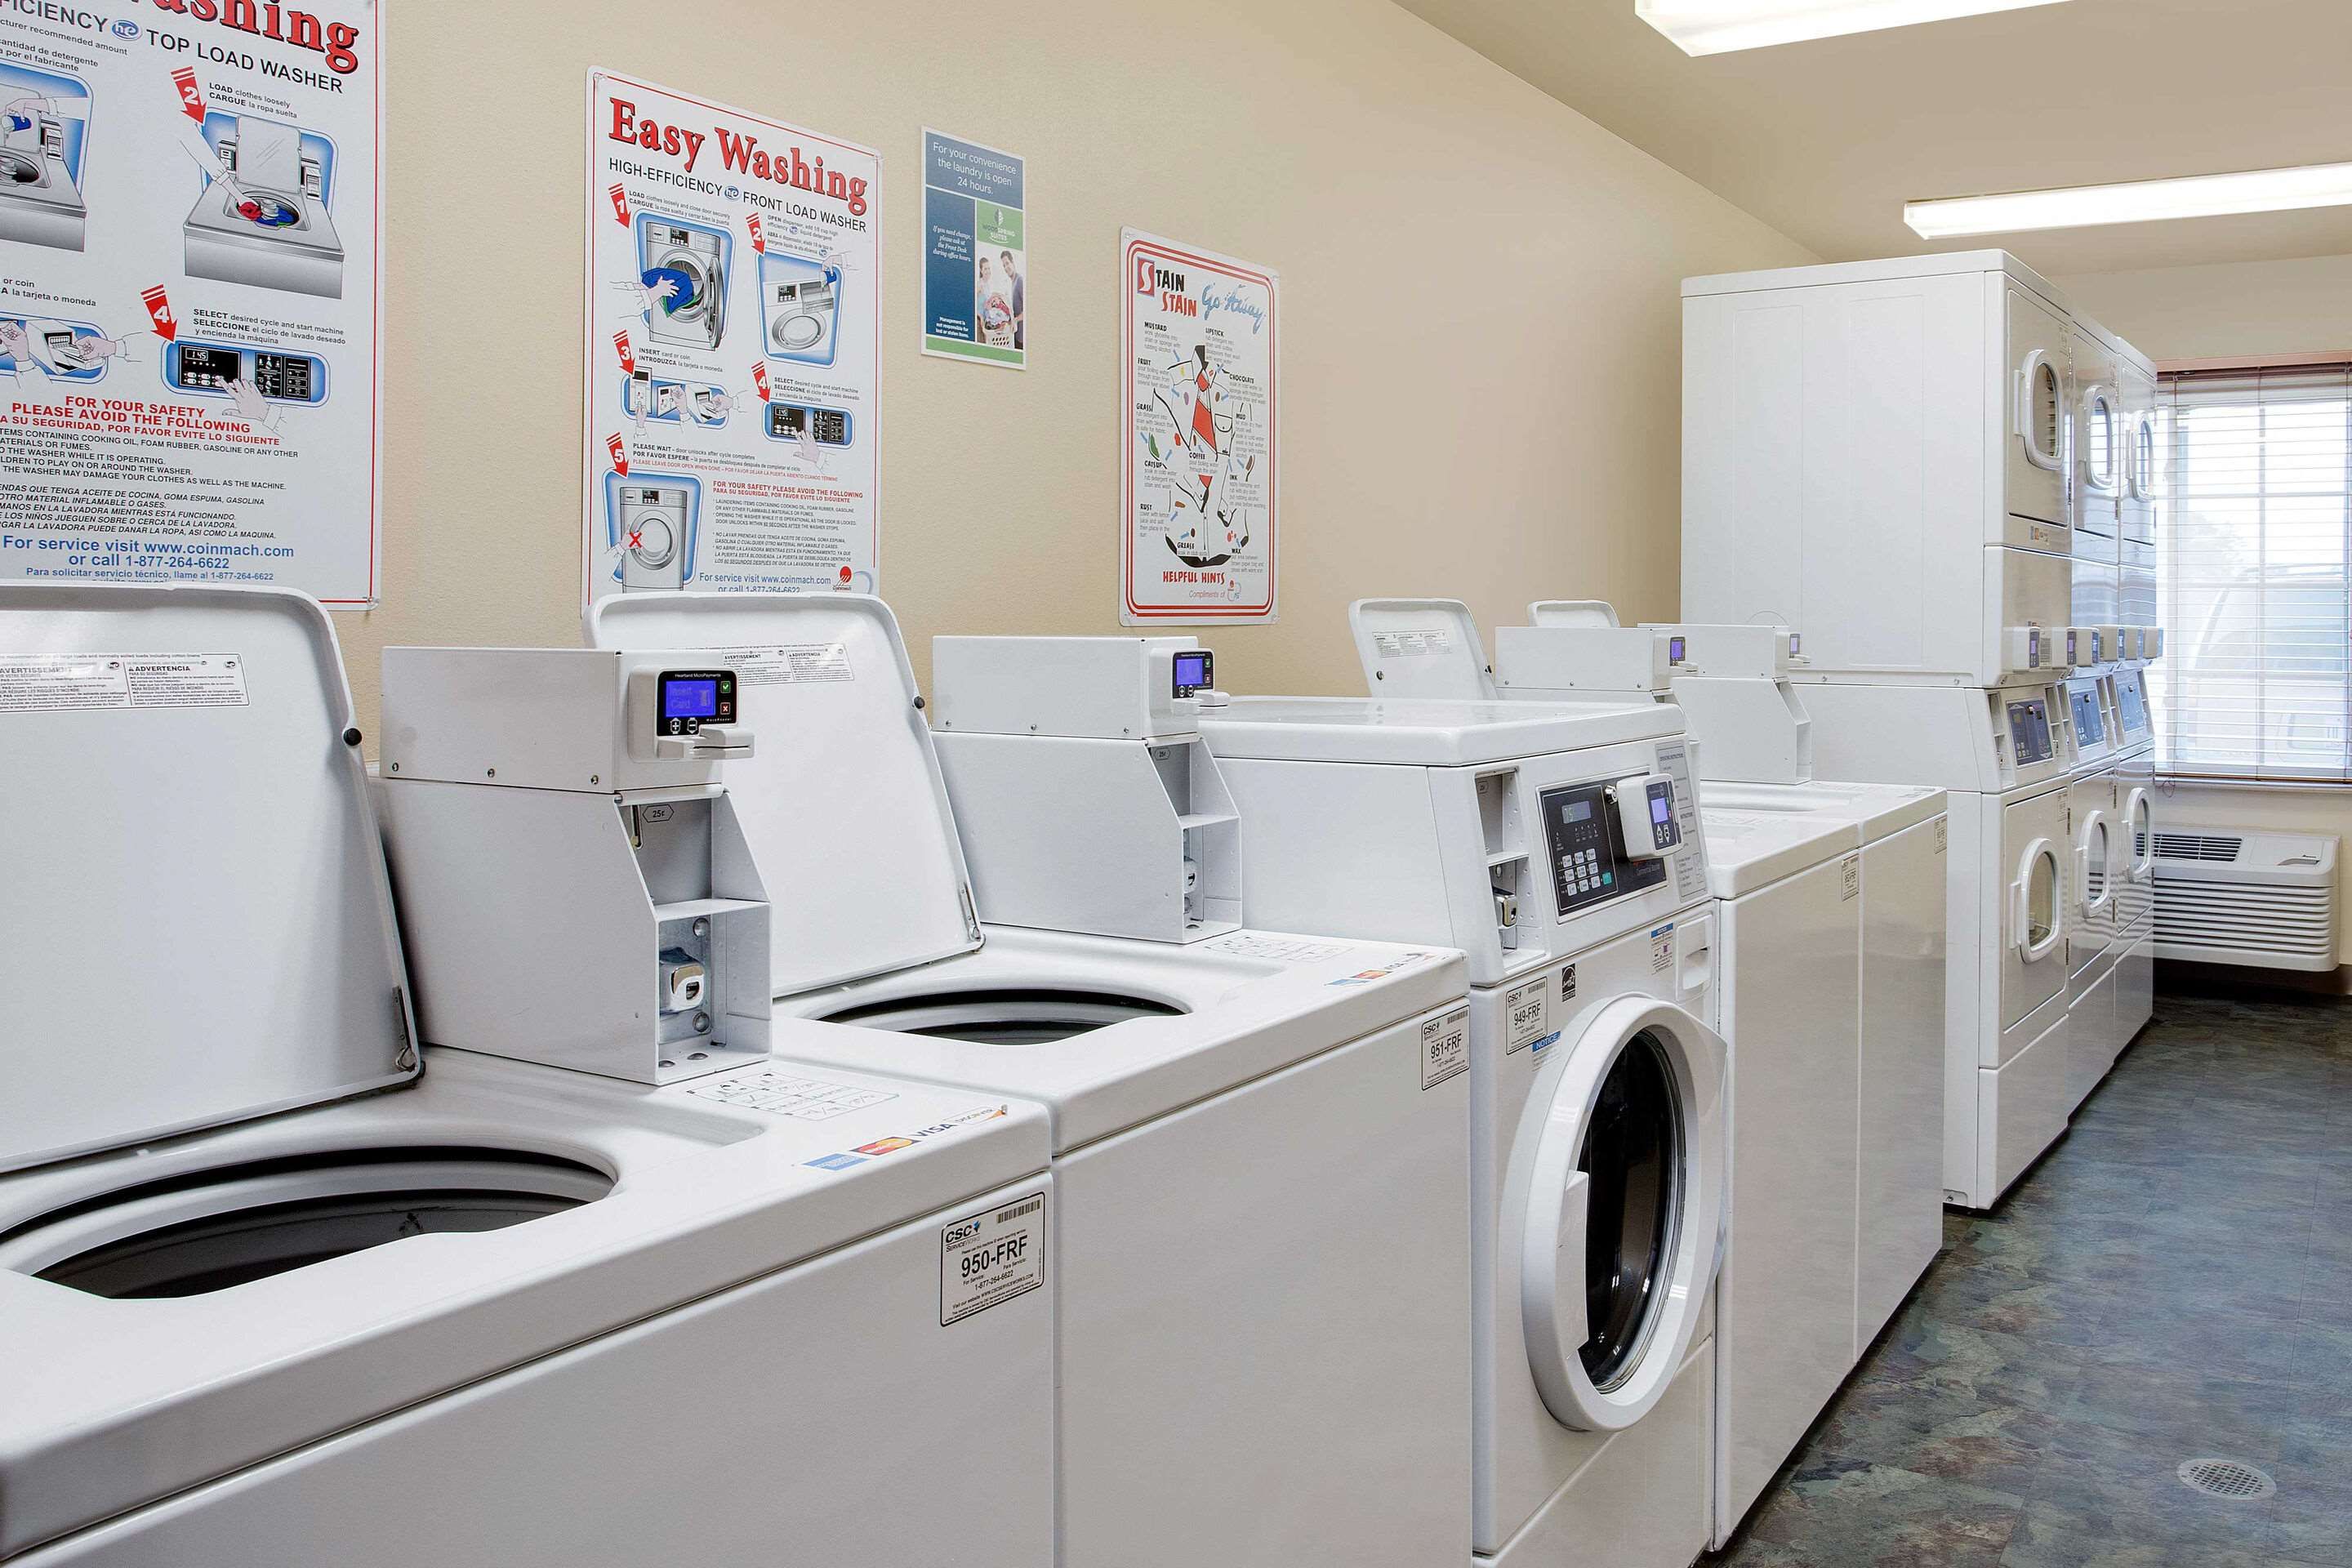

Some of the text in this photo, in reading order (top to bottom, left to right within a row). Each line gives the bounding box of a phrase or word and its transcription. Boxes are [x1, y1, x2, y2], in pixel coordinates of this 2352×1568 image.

[146, 29, 190, 52] TOP
[198, 42, 253, 70] LOAD
[260, 59, 343, 93] WASHER
[183, 86, 199, 105] 2
[209, 82, 291, 109] LOAD clothes loosely
[209, 91, 297, 118] CARGUE la ropa suelta
[608, 97, 868, 216] Easy Washing
[933, 142, 1017, 175] For your convenience
[938, 157, 1013, 186] the laundry is open
[957, 176, 994, 194] 24 hours.
[609, 157, 723, 197] HIGH-EFFICIENCY
[743, 191, 782, 212] FRONT
[786, 203, 817, 220] LOAD
[820, 210, 866, 234] WASHER
[629, 189, 645, 199] LOAD
[617, 199, 625, 214] 1
[629, 198, 653, 209] CARGUE
[753, 227, 761, 241] 2
[1138, 258, 1184, 294] STAIN
[1161, 291, 1197, 318] STAIN
[154, 305, 170, 323] 4
[193, 308, 344, 336] SELECT desired cycle and start machine
[1144, 321, 1168, 332] MUSTARD
[193, 318, 250, 332] SELECCIONE
[261, 327, 278, 336] ciclo
[279, 330, 290, 338] de
[291, 330, 314, 341] lavado
[315, 334, 346, 345] deseado
[195, 328, 200, 336] y
[202, 328, 237, 340] encienda
[1205, 327, 1225, 337] LIPSTICK
[621, 345, 630, 361] 3
[639, 347, 660, 356] INSERT
[639, 355, 676, 366] INTRODUZCA
[1137, 358, 1152, 367] FRUIT
[774, 376, 795, 385] SELECT
[774, 384, 805, 394] SELECCIONE
[65, 395, 206, 418] FOR YOUR SAFETY
[12, 403, 250, 433] PLEASE AVOID THE FOLLOWING
[12, 416, 28, 425] SU
[33, 418, 105, 433] SEGURIDAD,
[108, 425, 131, 434] POR
[134, 426, 171, 436] FAVOR
[175, 430, 206, 439] EVITE
[209, 433, 222, 441] LO
[225, 434, 280, 446] SIGUIENTE
[25, 430, 79, 441] CONTAINING
[81, 434, 121, 444] COOKING
[122, 438, 139, 446] OIL,
[140, 439, 163, 448] FOAM
[203, 444, 243, 454] GASOLINE
[274, 450, 299, 458] OTHER
[633, 443, 671, 452] PLEASE WAIT
[614, 448, 624, 463] 5
[668, 453, 689, 461] ESPERE
[1189, 452, 1206, 461] COFFEE
[1144, 461, 1163, 469] CATSUP
[1230, 474, 1238, 482] INK
[773, 485, 795, 493] PLEASE
[797, 487, 815, 495] AVOID
[830, 490, 863, 498] FOLLOWING
[1140, 503, 1153, 511] RUST
[3, 536, 294, 557] For service visit www.coinmach.com
[1177, 541, 1195, 550] GREASE
[69, 554, 229, 569] or call 1-877-264-6622
[26, 567, 49, 576] Para
[52, 568, 92, 577] solicitar
[95, 568, 132, 578] servicio
[174, 571, 198, 579] llame
[211, 572, 274, 580] 1-877-264-6622
[699, 572, 831, 585] For service visit www.coinmach.com
[1163, 571, 1225, 585] HELPFUL HINTS
[1188, 590, 1219, 599] Compliments
[1508, 993, 1519, 1003] CSC
[1514, 1003, 1541, 1026] 949-FRF
[1423, 1023, 1437, 1036] CSC
[1431, 1032, 1462, 1059] 951-FRF
[911, 1124, 960, 1137] VISA
[946, 1225, 973, 1243] CSC
[961, 1235, 1027, 1278] 950-FRF
[975, 1269, 1013, 1292] 1-877-264-6622
